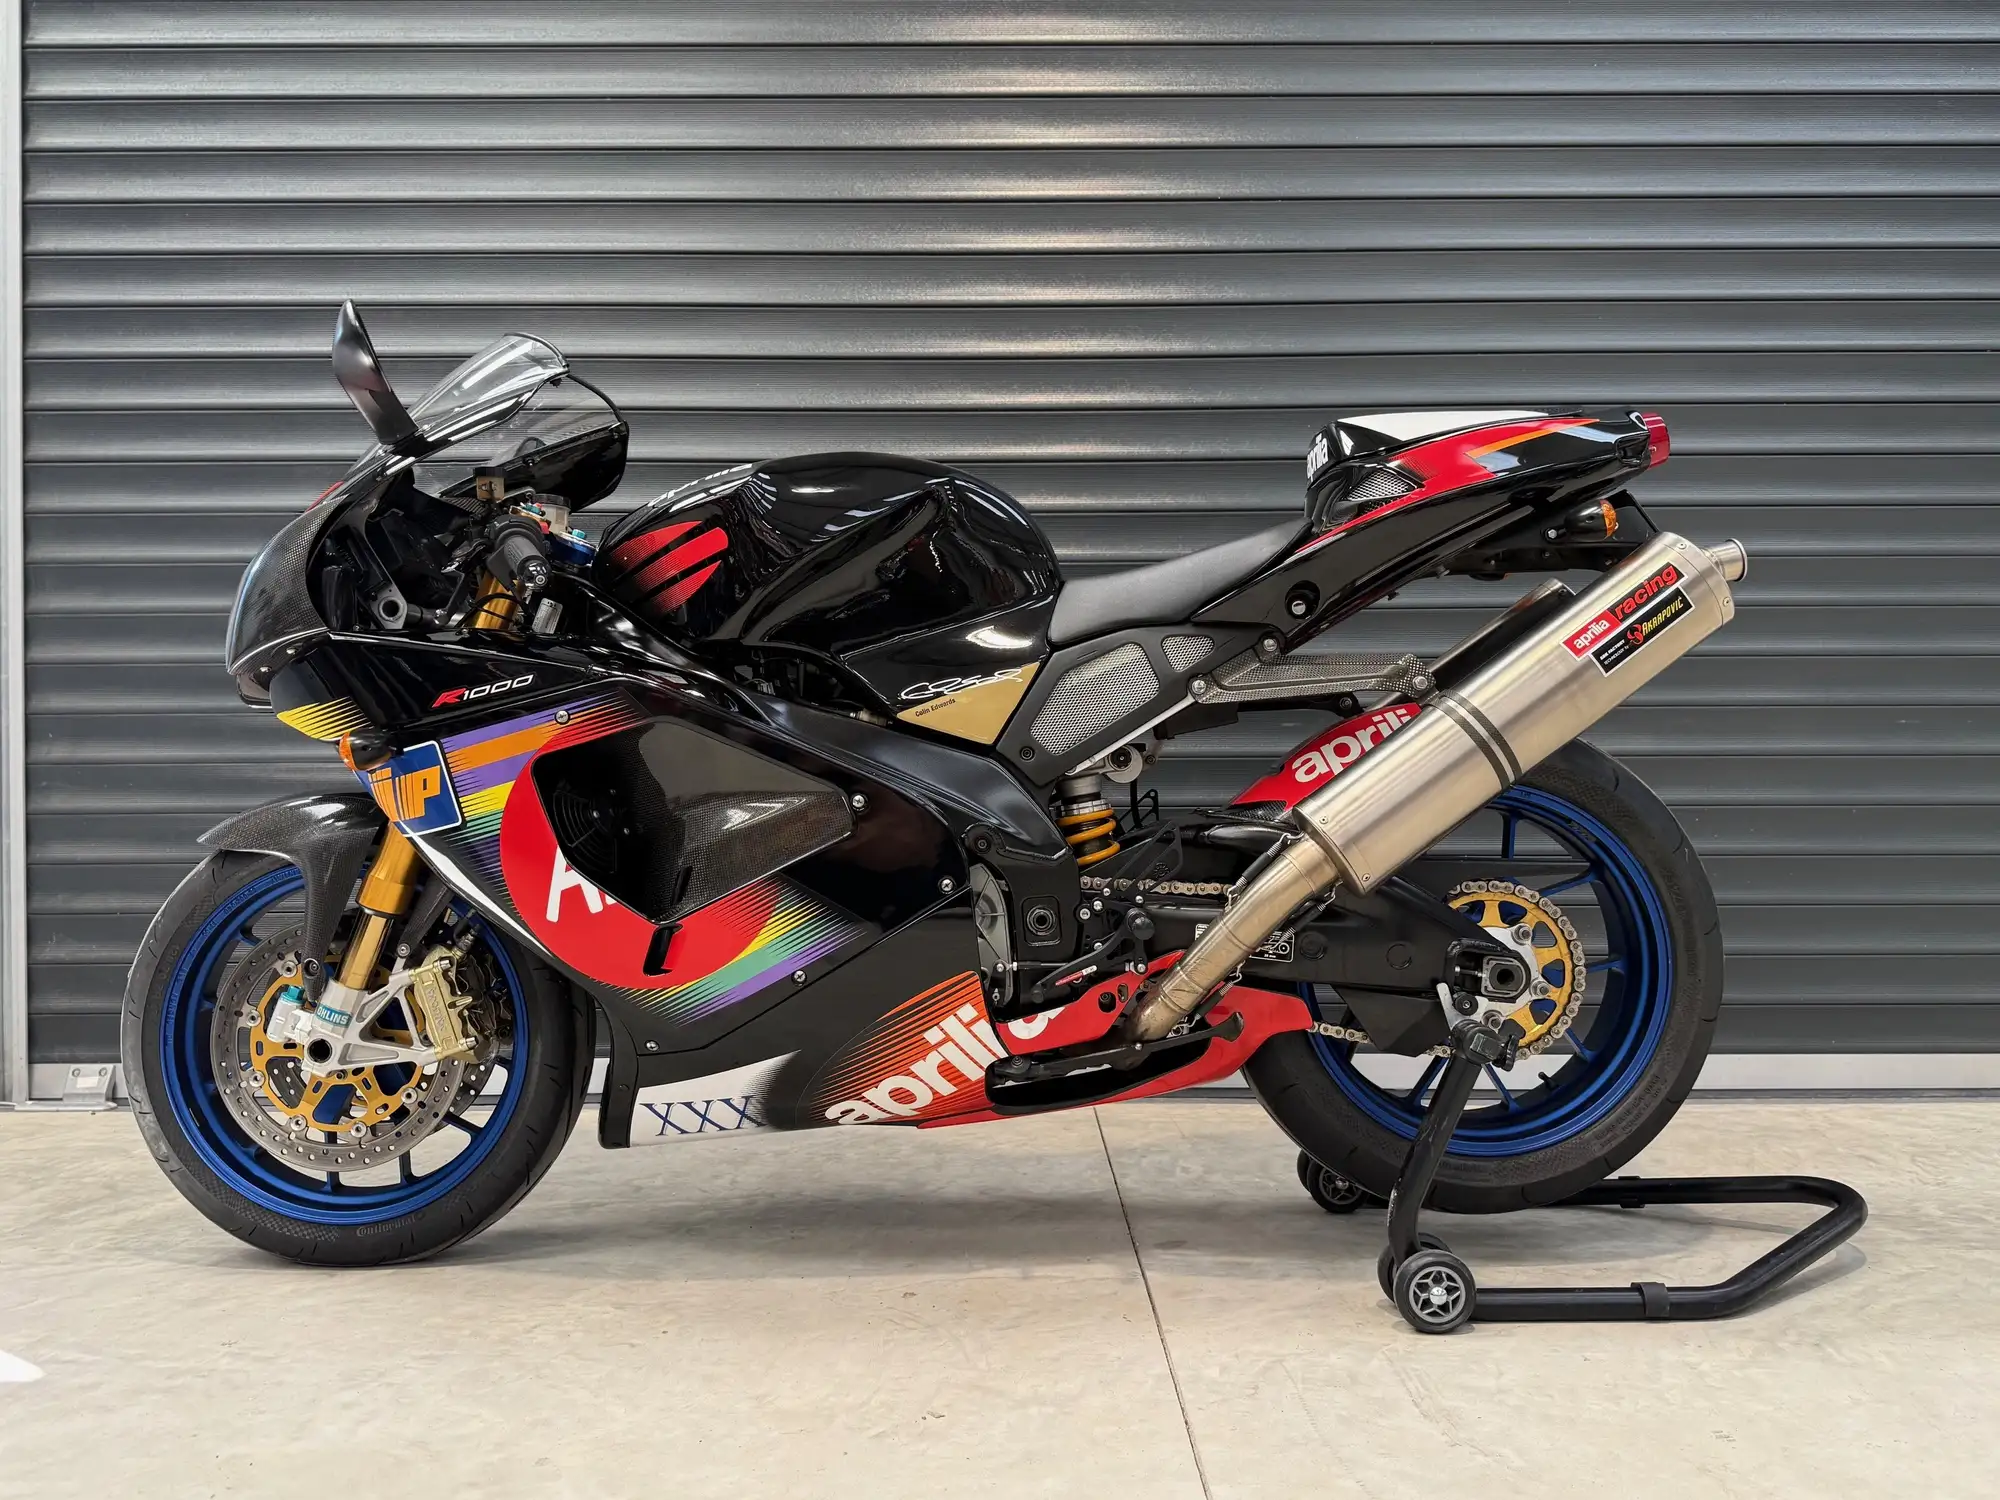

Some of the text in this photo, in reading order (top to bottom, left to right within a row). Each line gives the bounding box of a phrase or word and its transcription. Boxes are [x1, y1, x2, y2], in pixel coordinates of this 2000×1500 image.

[1573, 565, 1678, 649] aprilia racing
[431, 675, 534, 708] R1000
[915, 698, 956, 718] Colin Edwards
[639, 1094, 768, 1136] XXX
